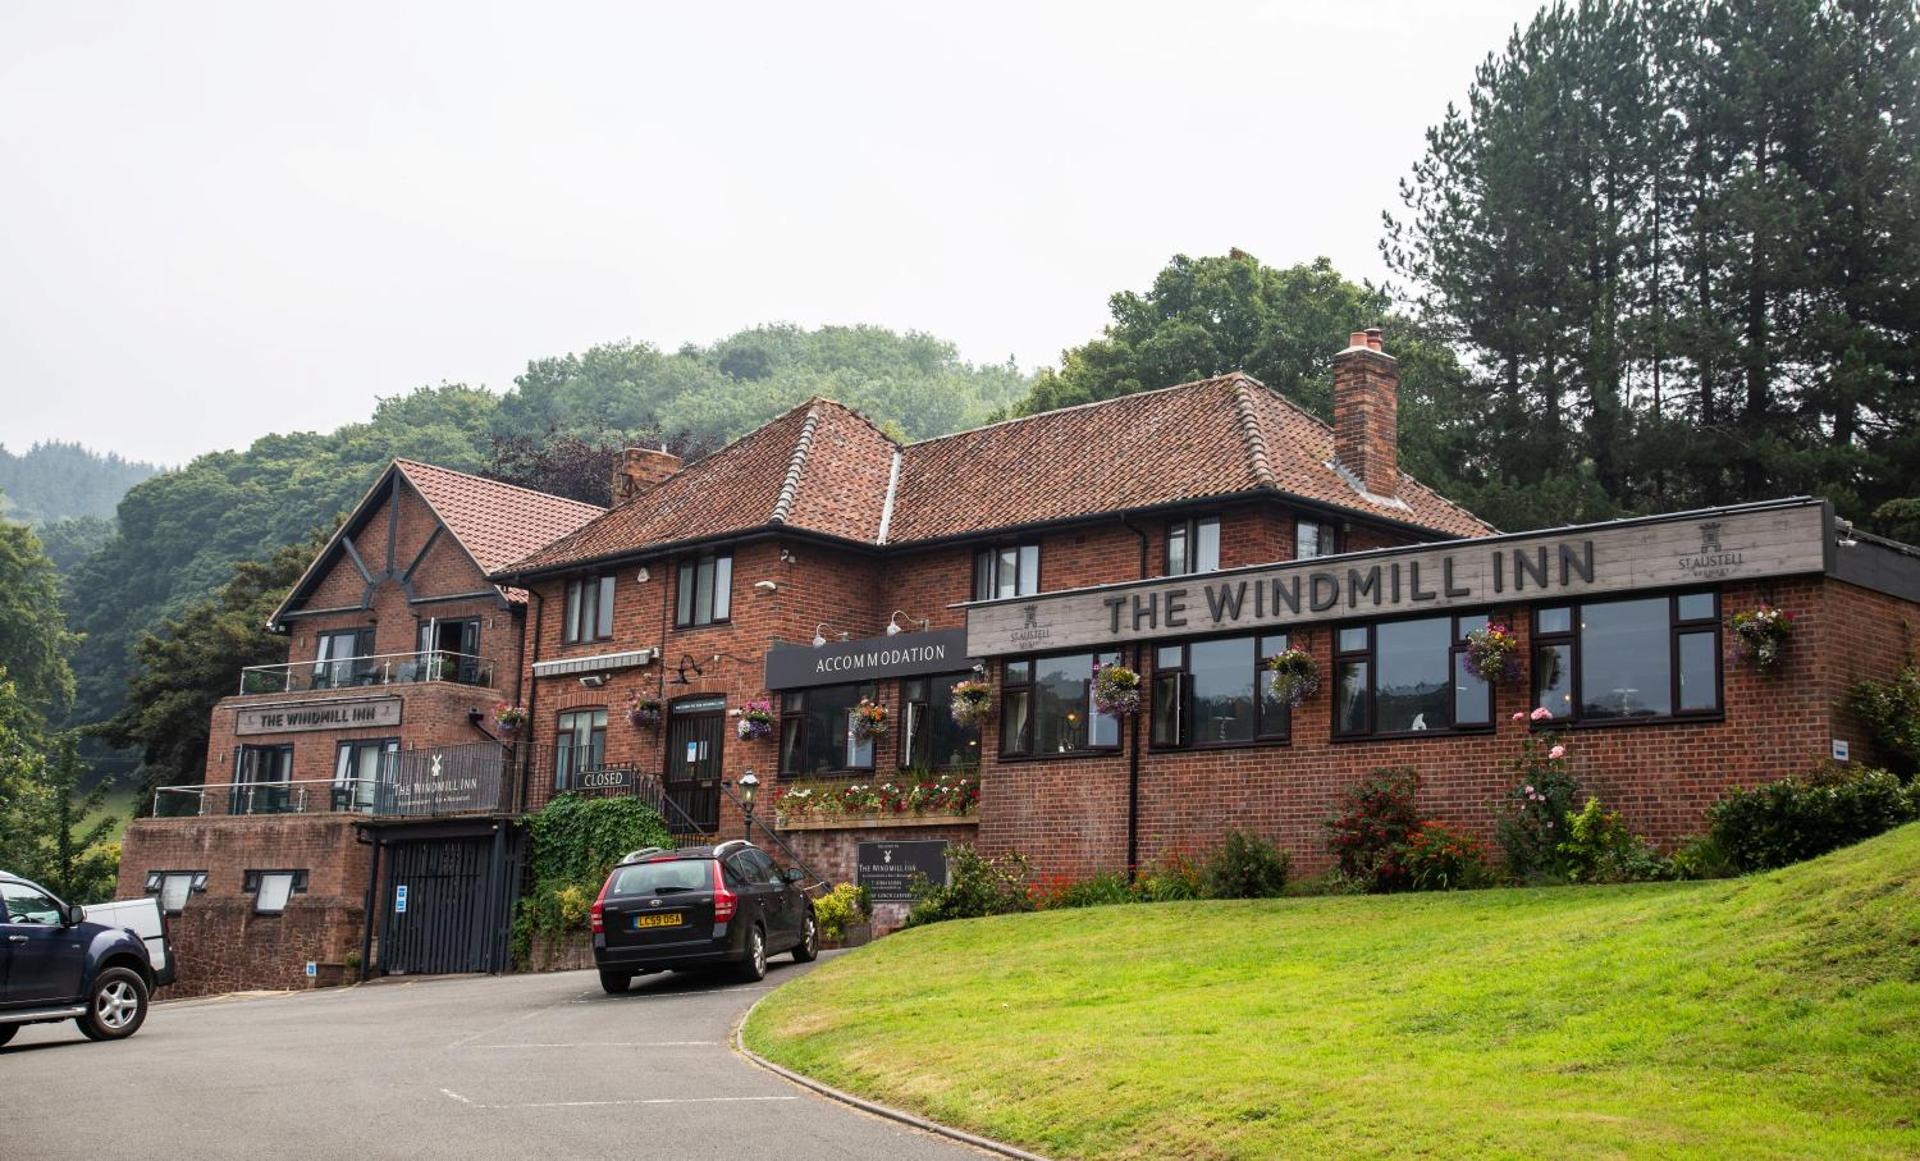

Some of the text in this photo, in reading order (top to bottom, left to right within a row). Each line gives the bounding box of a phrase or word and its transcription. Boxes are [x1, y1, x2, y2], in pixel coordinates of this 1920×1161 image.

[1693, 552, 1744, 569] AUSTELL
[1104, 540, 1595, 633] THE WINDMILL INN
[815, 644, 945, 673] ACCOMMODATION
[260, 707, 376, 728] THE WINDMILL INN
[392, 777, 478, 796] THE WINDMILL INN
[584, 771, 623, 787] CLOSED
[859, 863, 871, 873] THE
[872, 864, 903, 872] WINDMILL
[639, 915, 662, 926] LC59
